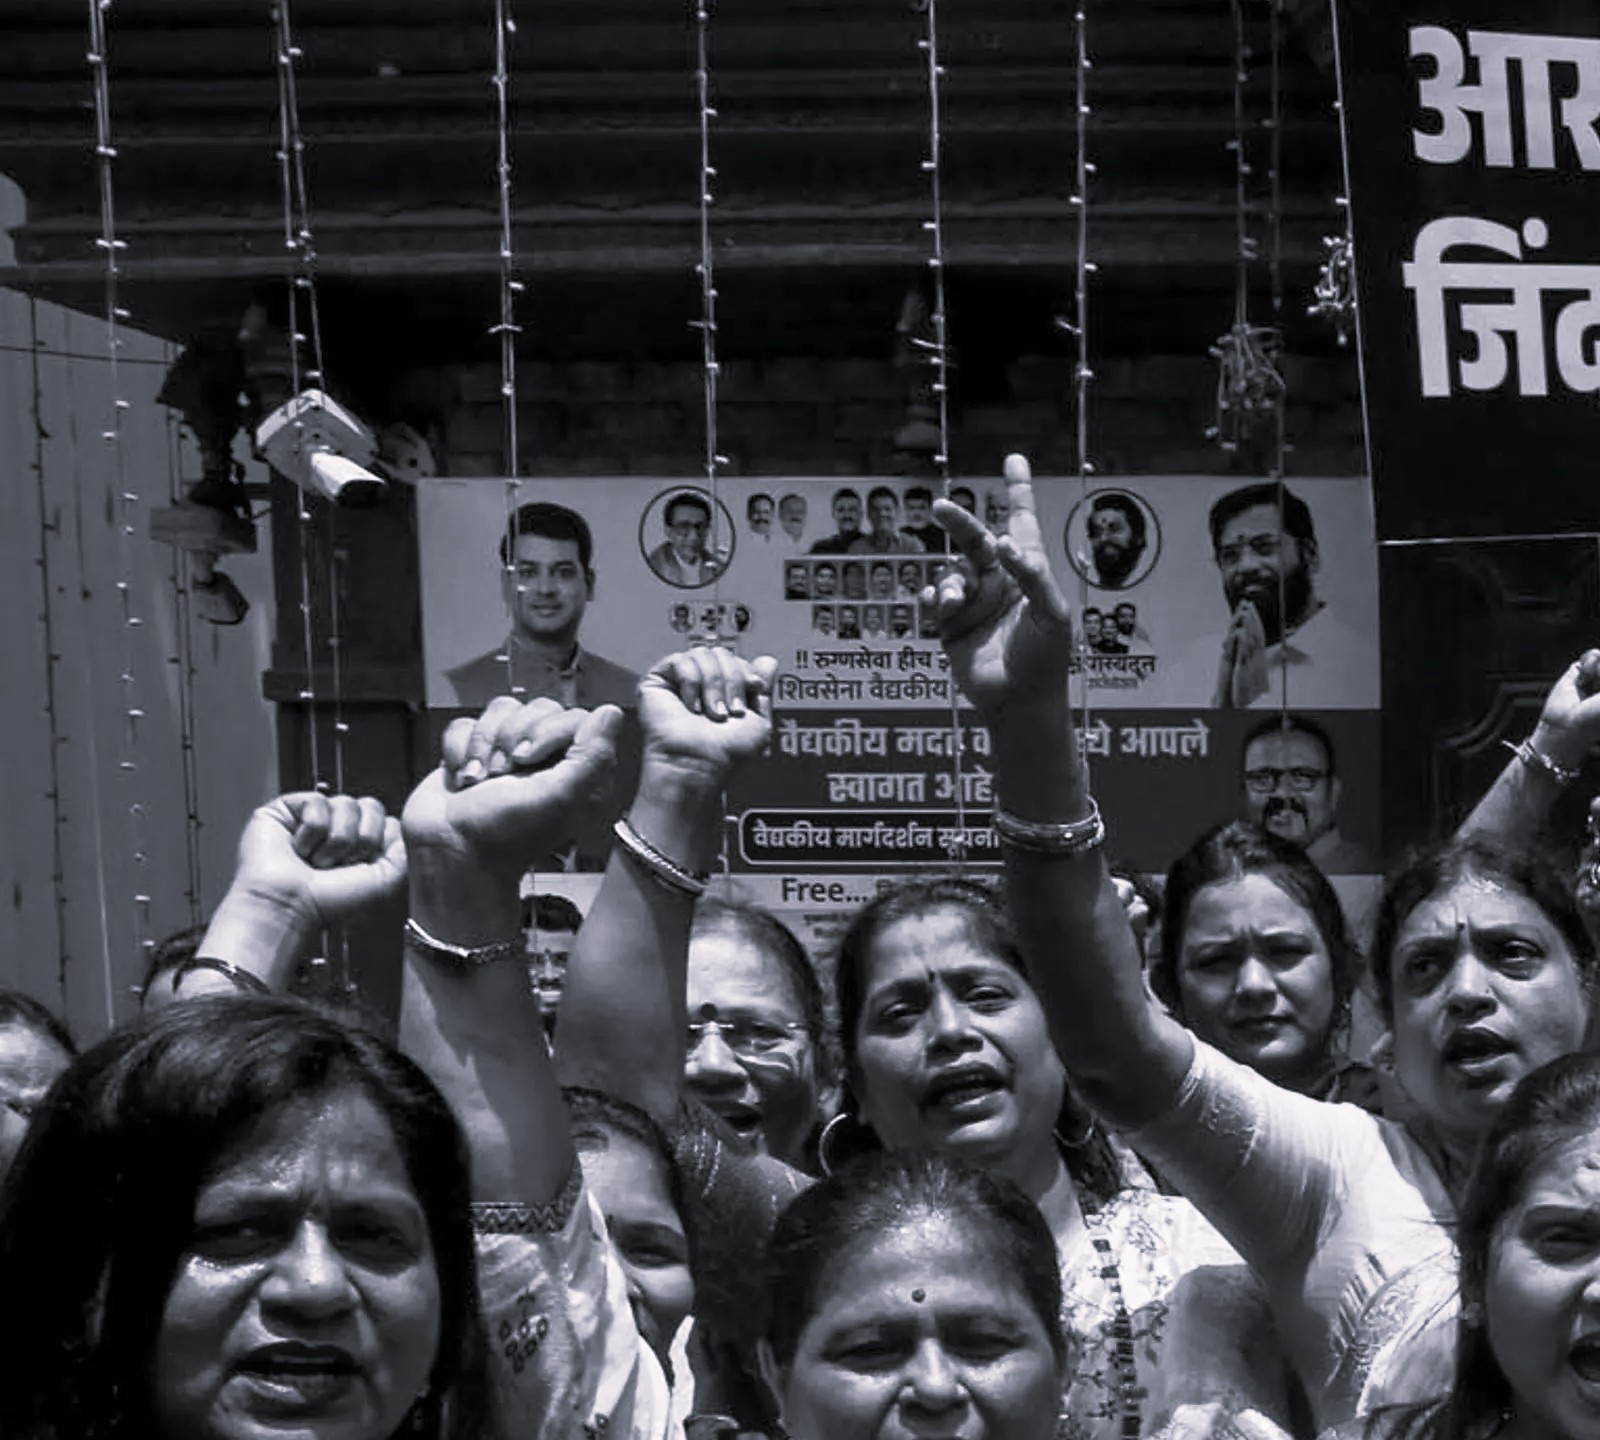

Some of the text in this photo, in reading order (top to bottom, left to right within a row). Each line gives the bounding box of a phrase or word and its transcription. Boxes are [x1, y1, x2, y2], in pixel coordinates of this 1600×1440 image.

[814, 647, 892, 670] रुग्णसेवा
[897, 647, 932, 671] हीच
[778, 672, 947, 700] शिवसेना वैद्यकीय
[777, 718, 889, 756] वैद्यकीय
[1119, 717, 1211, 757] आपले
[826, 772, 926, 802] स्वागत
[751, 818, 831, 849] वैद्यकीय
[836, 821, 933, 849] मार्गदर्शन
[781, 877, 868, 903] Free...
